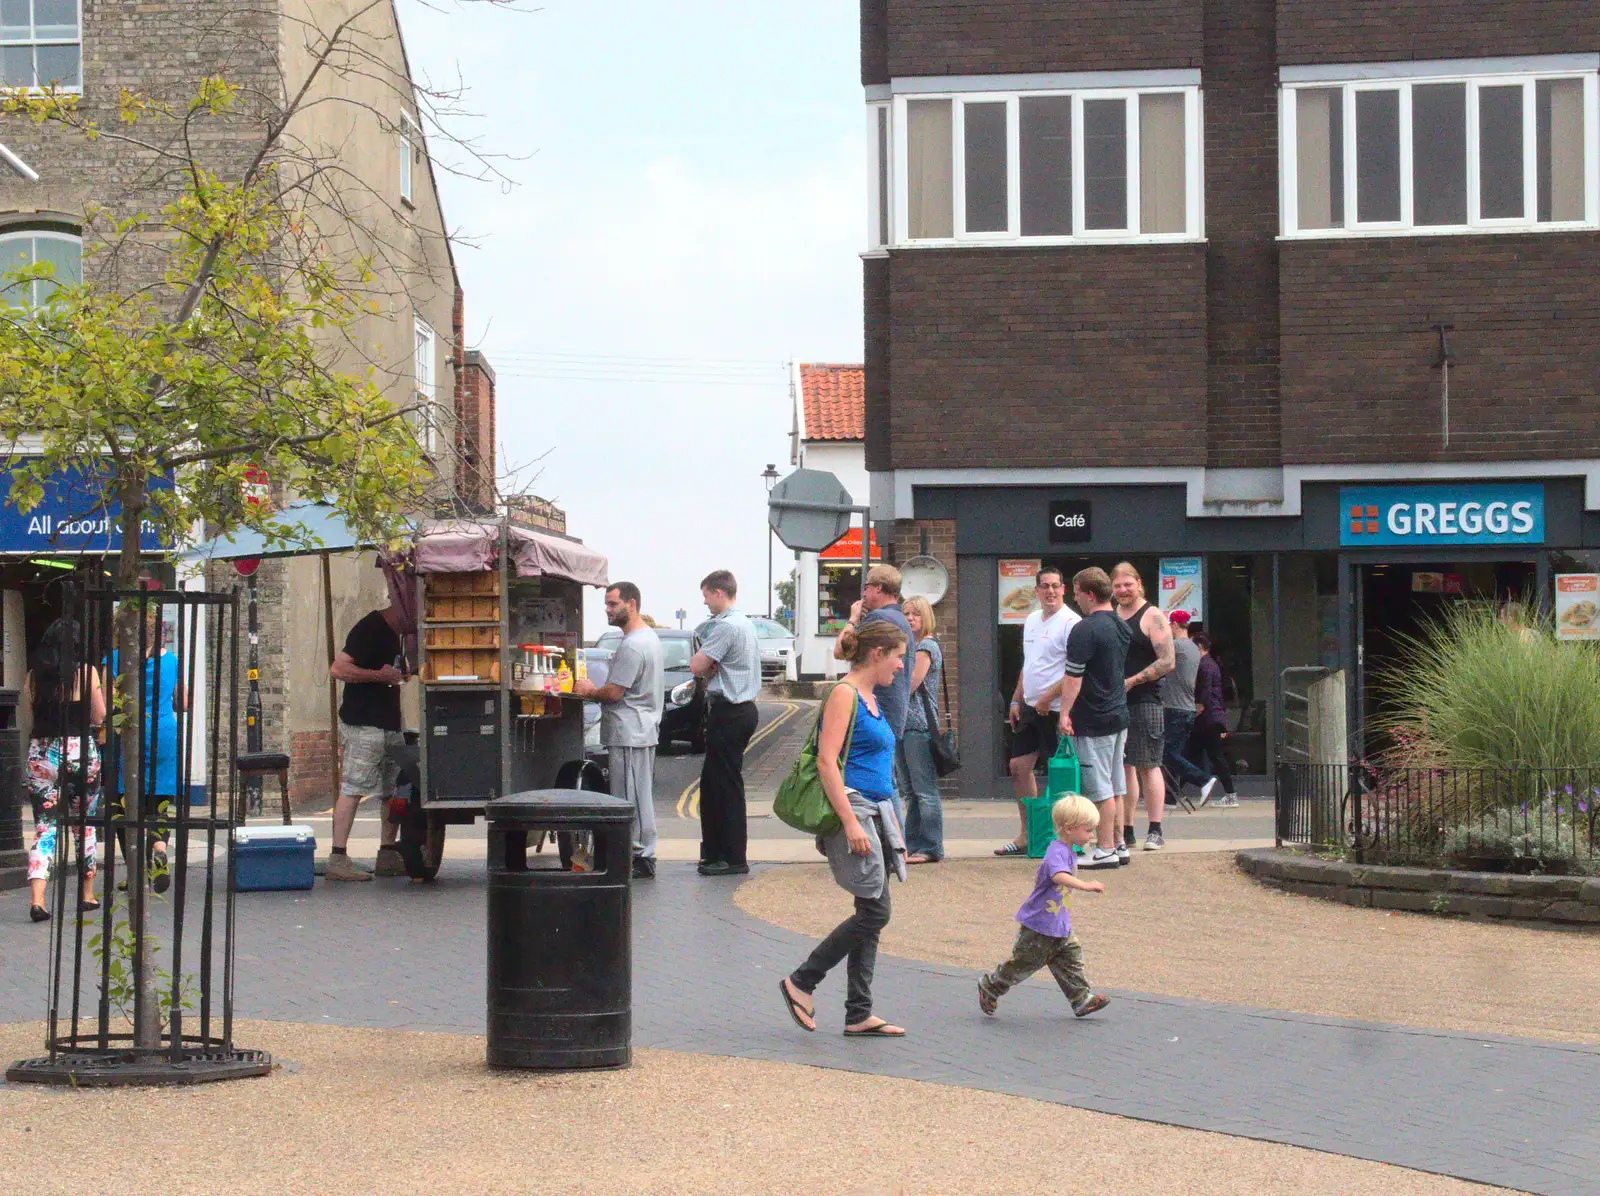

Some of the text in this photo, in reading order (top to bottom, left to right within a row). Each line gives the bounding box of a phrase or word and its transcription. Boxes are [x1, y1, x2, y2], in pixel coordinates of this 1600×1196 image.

[27, 515, 51, 535] All
[57, 515, 110, 535] about
[1054, 513, 1086, 528] Café
[1387, 501, 1534, 535] GREGGS
